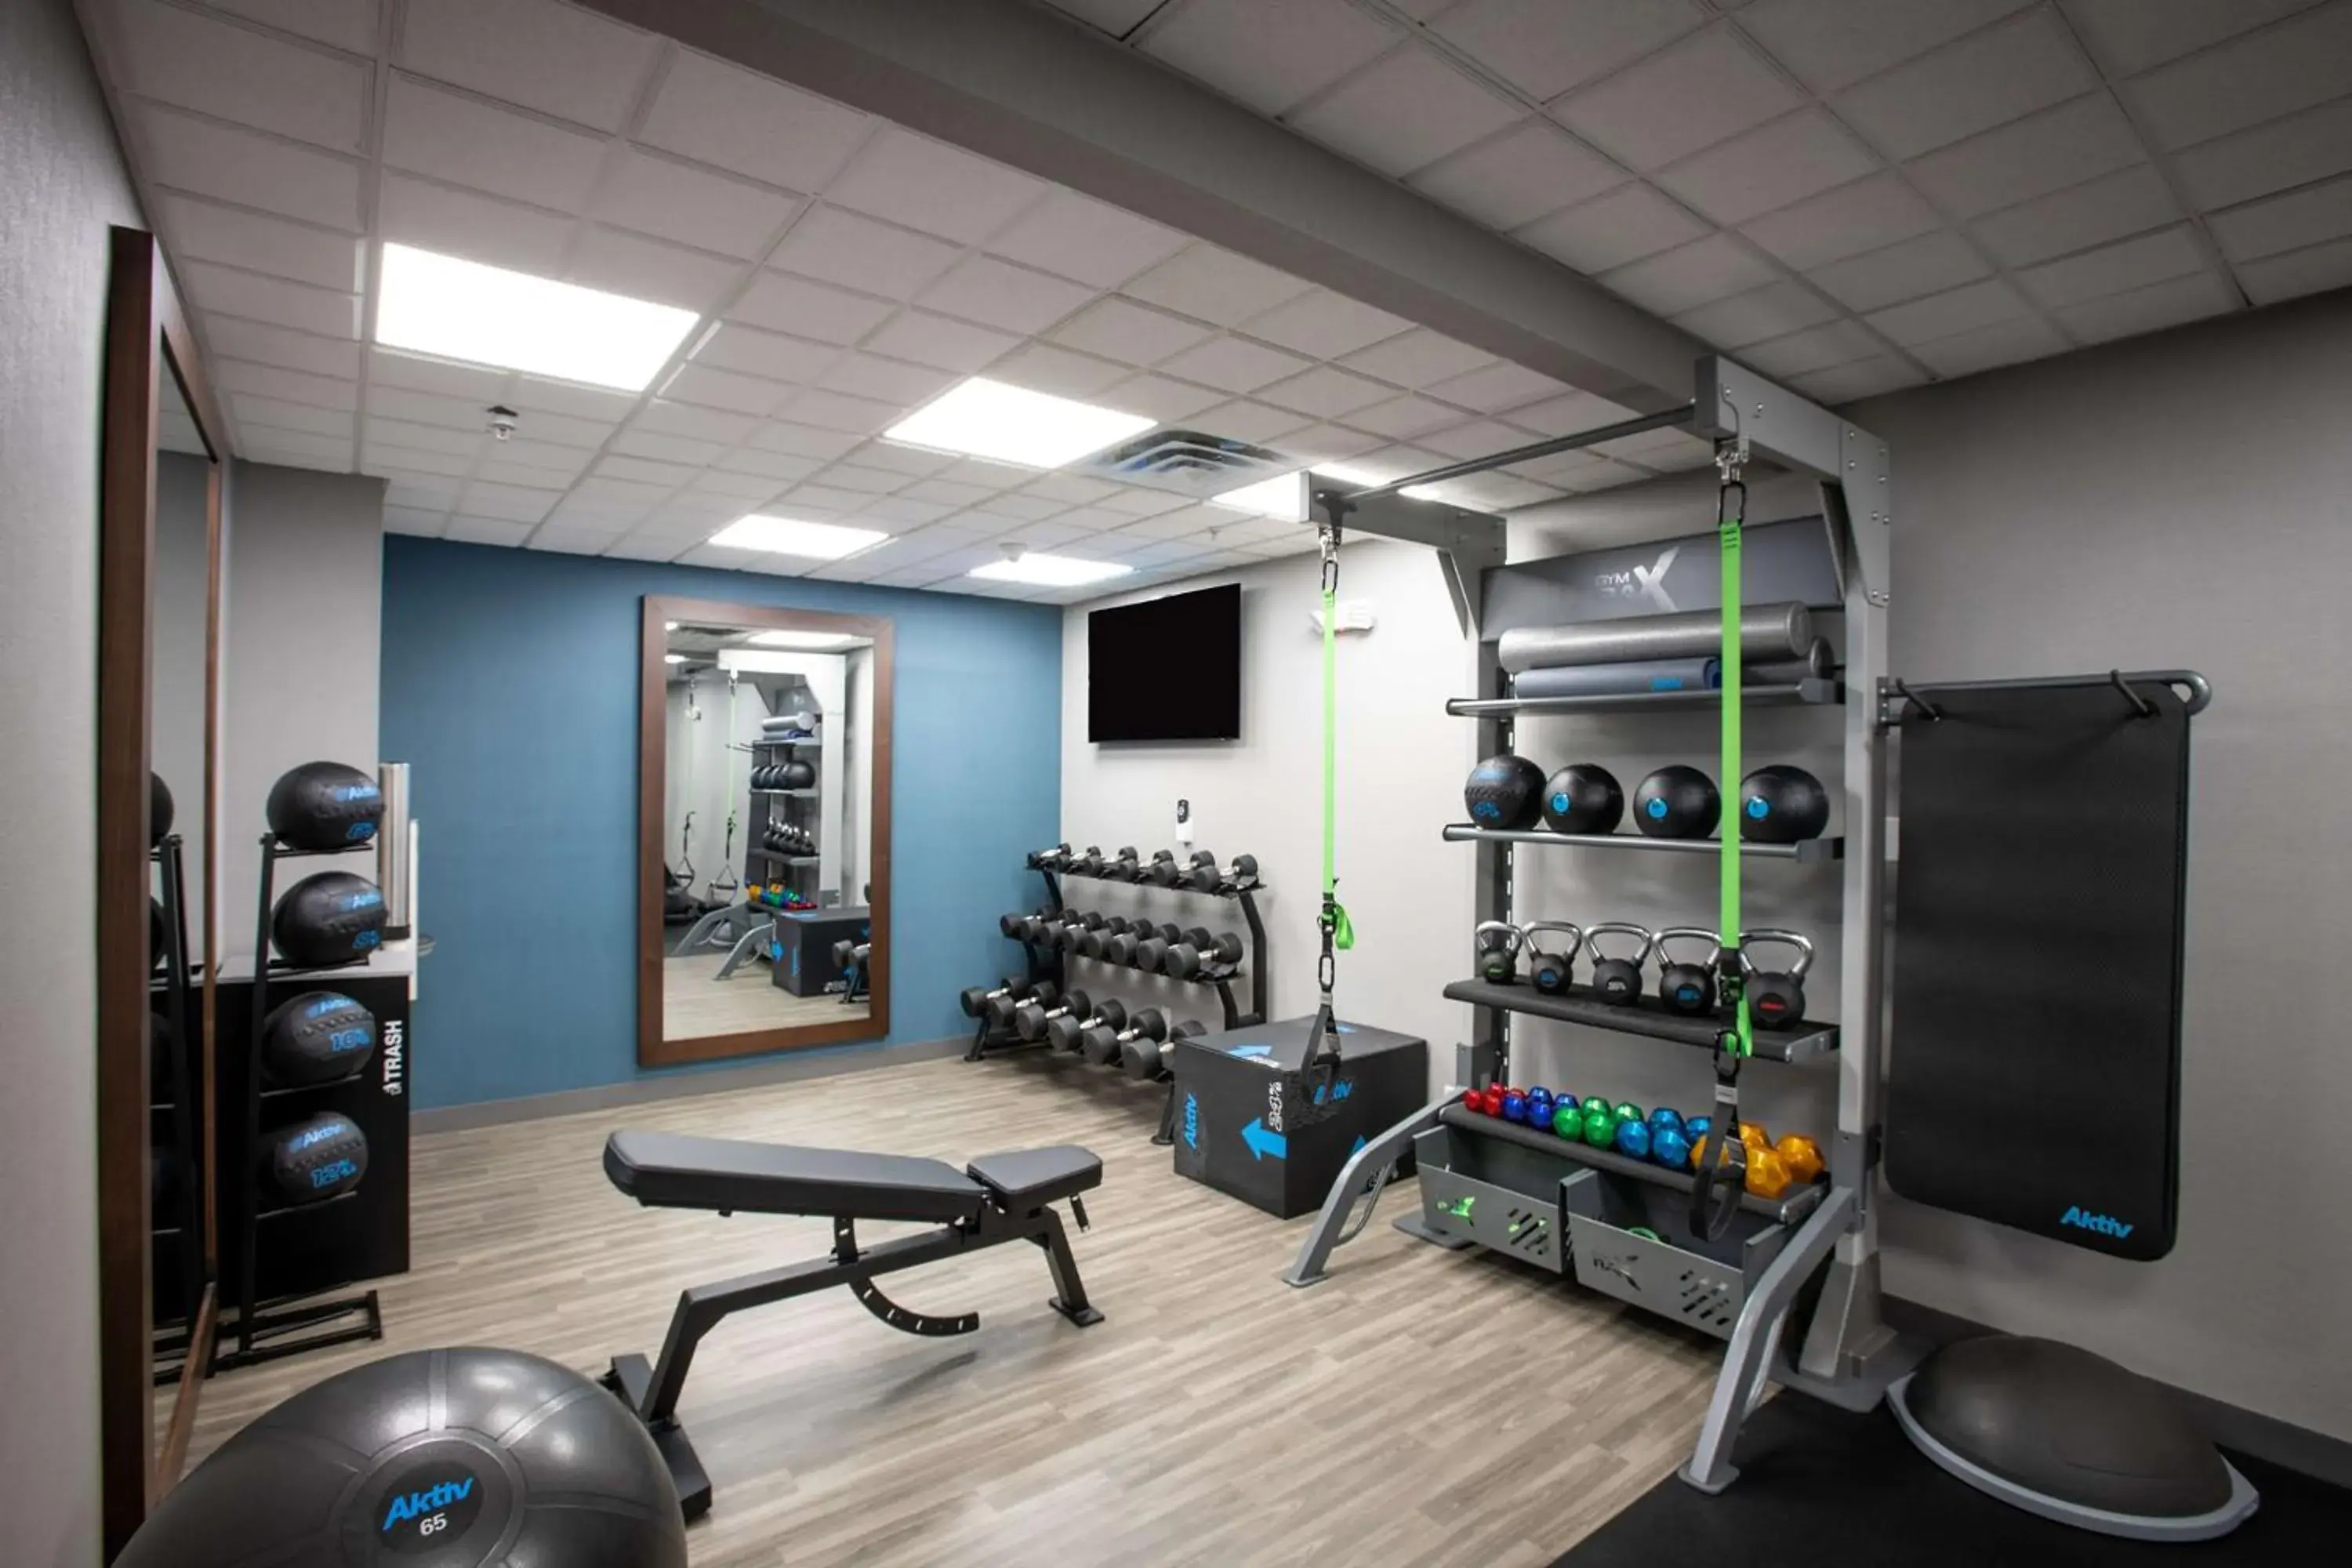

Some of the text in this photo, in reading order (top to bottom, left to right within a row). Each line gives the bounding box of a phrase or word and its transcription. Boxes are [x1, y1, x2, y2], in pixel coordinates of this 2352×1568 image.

[383, 1020, 402, 1082] TRASH
[2060, 1205, 2134, 1239] Aktiv
[382, 1477, 474, 1530] Aktiv
[419, 1512, 448, 1537] 65
